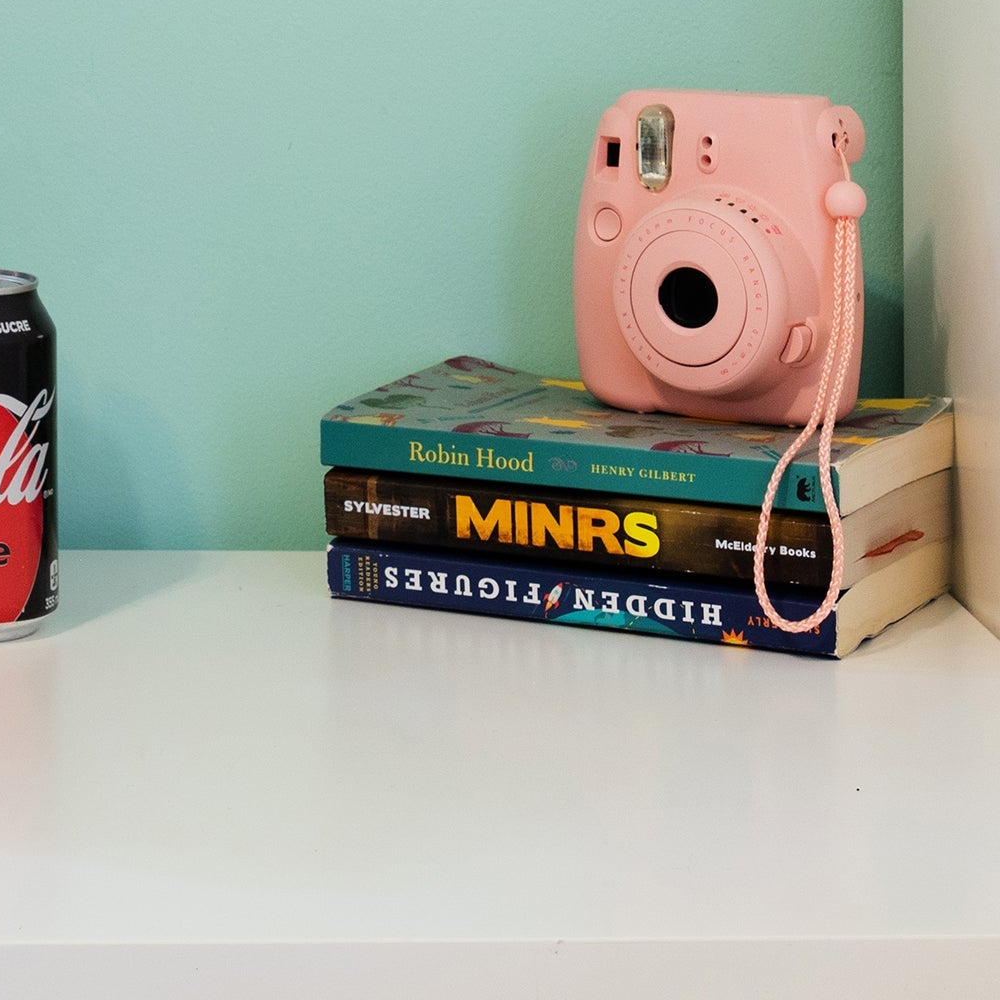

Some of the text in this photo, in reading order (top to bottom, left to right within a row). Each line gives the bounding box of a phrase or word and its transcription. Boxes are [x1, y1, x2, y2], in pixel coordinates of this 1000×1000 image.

[688, 215, 735, 243] FOCUS
[408, 441, 534, 473] Robin Hood
[591, 464, 696, 483] HENRY GILBERT
[343, 500, 431, 520] SYLVESTER
[455, 494, 660, 559] MINRS
[715, 539, 817, 559] McEldery Books
[343, 554, 352, 592] HARPER
[384, 566, 723, 627] HIDDEN FIGURES
